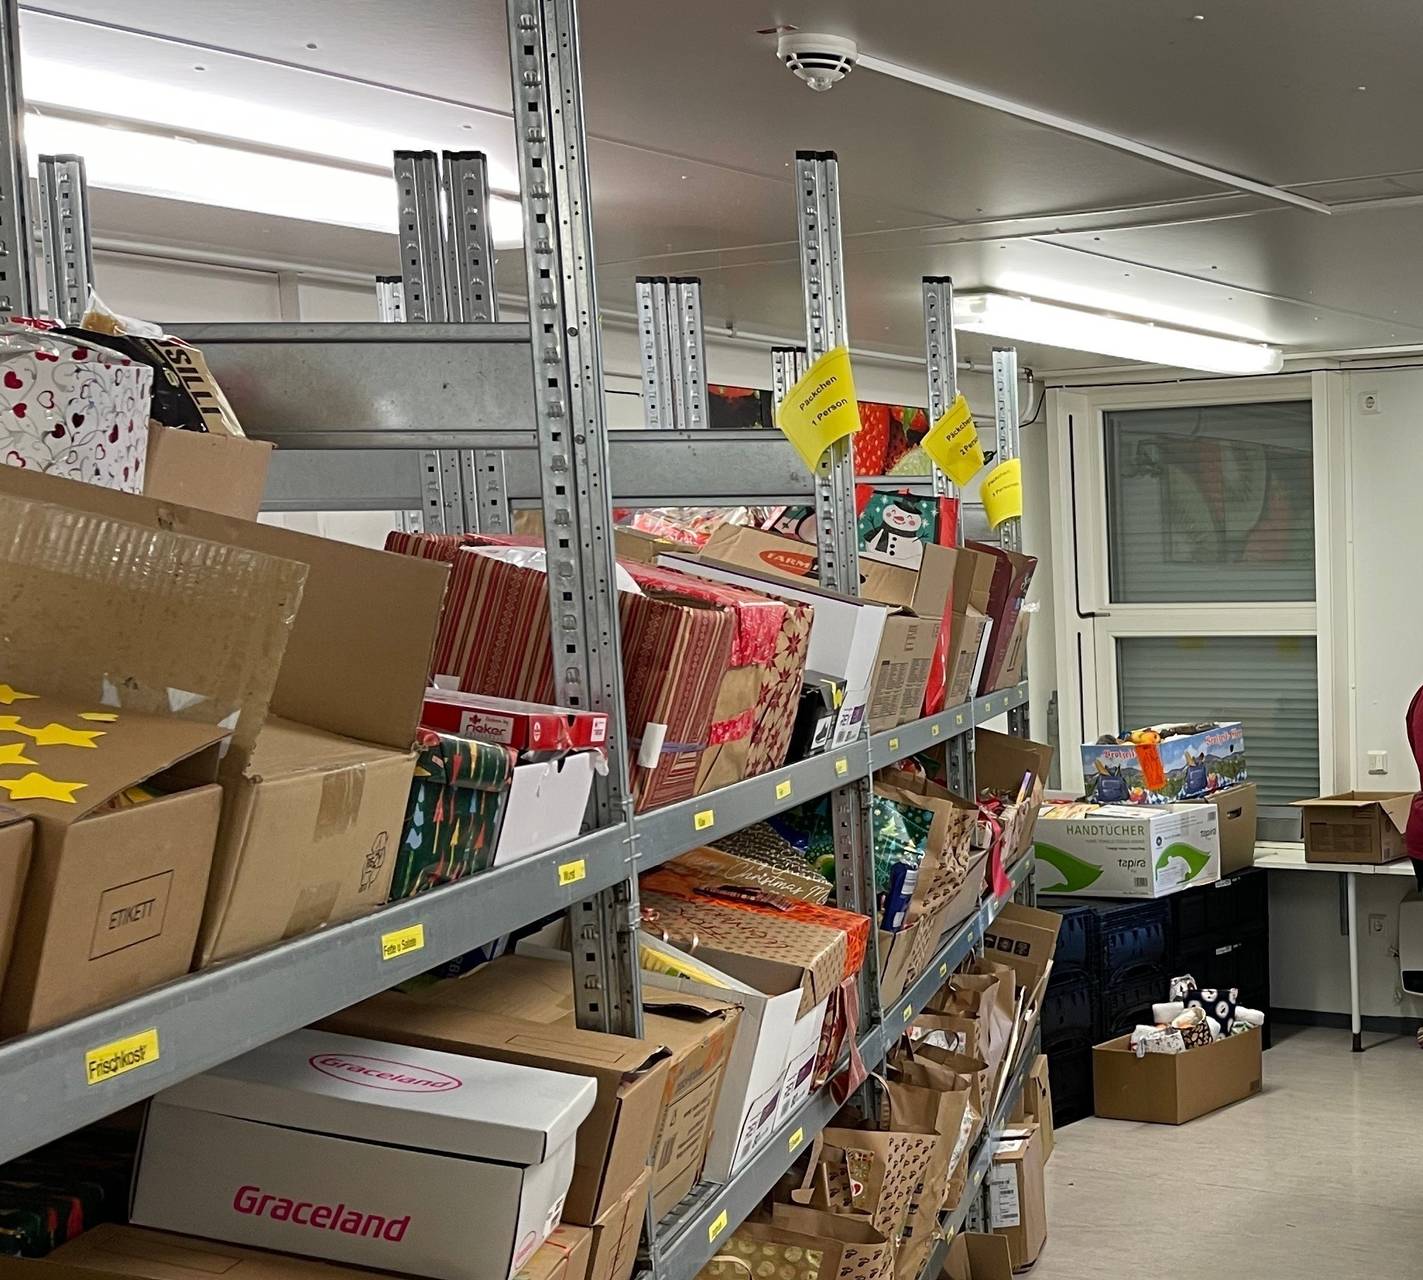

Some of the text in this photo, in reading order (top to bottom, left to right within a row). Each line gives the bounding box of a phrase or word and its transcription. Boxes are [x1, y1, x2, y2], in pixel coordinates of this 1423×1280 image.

[799, 375, 838, 412] Päckchen
[816, 397, 849, 422] Person
[1066, 823, 1145, 836] HANDTÜCHER
[1117, 857, 1146, 869] tapira
[723, 864, 805, 896] Christmas
[108, 897, 155, 930] ETIKETT
[89, 1045, 148, 1080] Frischkost
[319, 1054, 453, 1090] Graceland
[233, 1184, 412, 1243] Graceland
